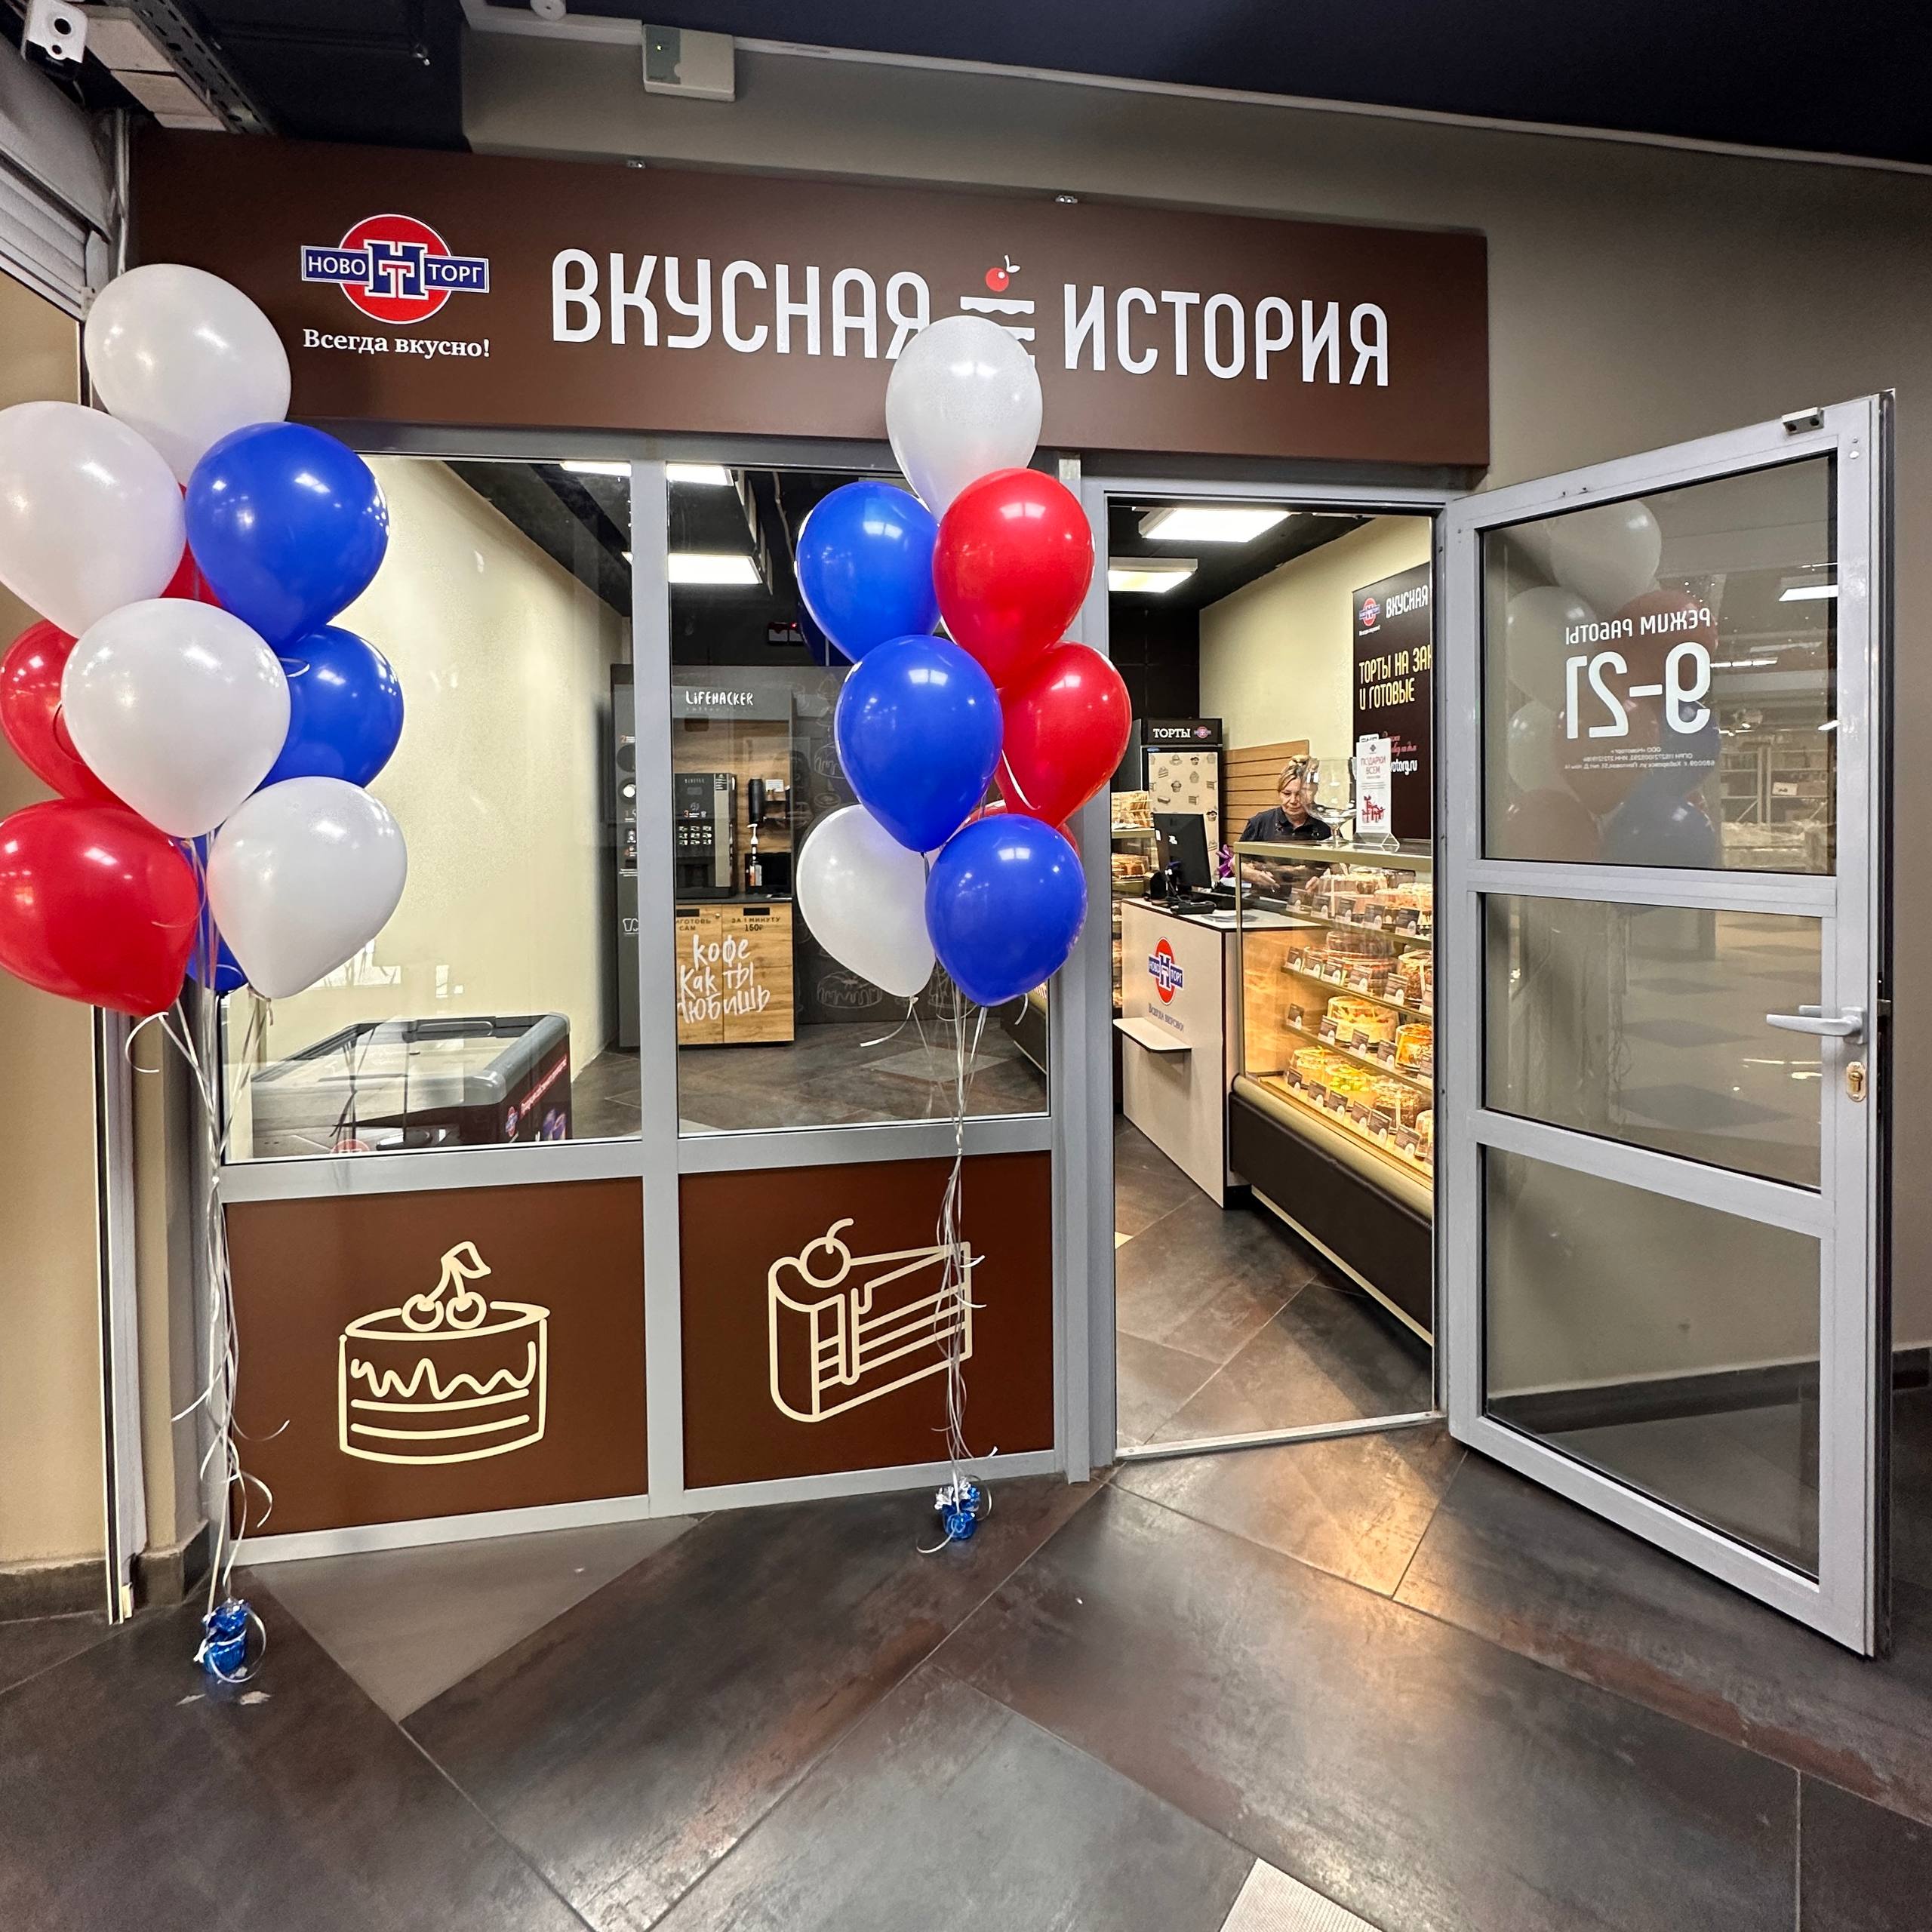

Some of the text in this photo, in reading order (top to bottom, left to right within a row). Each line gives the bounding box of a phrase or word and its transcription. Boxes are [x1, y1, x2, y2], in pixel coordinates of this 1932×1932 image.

[308, 256, 366, 275] НОВО
[427, 263, 483, 283] ТОРГ
[552, 248, 1389, 387] ВКУСНАЯ ИСТОРИЯ
[303, 328, 490, 359] Всегда вкусно!
[1386, 585, 1429, 619] ВКУСНАЯ
[1358, 654, 1392, 685] ТОРТЫ
[1394, 650, 1410, 677] НА
[1368, 677, 1416, 709] ГОТОВЫЕ
[1152, 728, 1192, 738] ТОРТЫ
